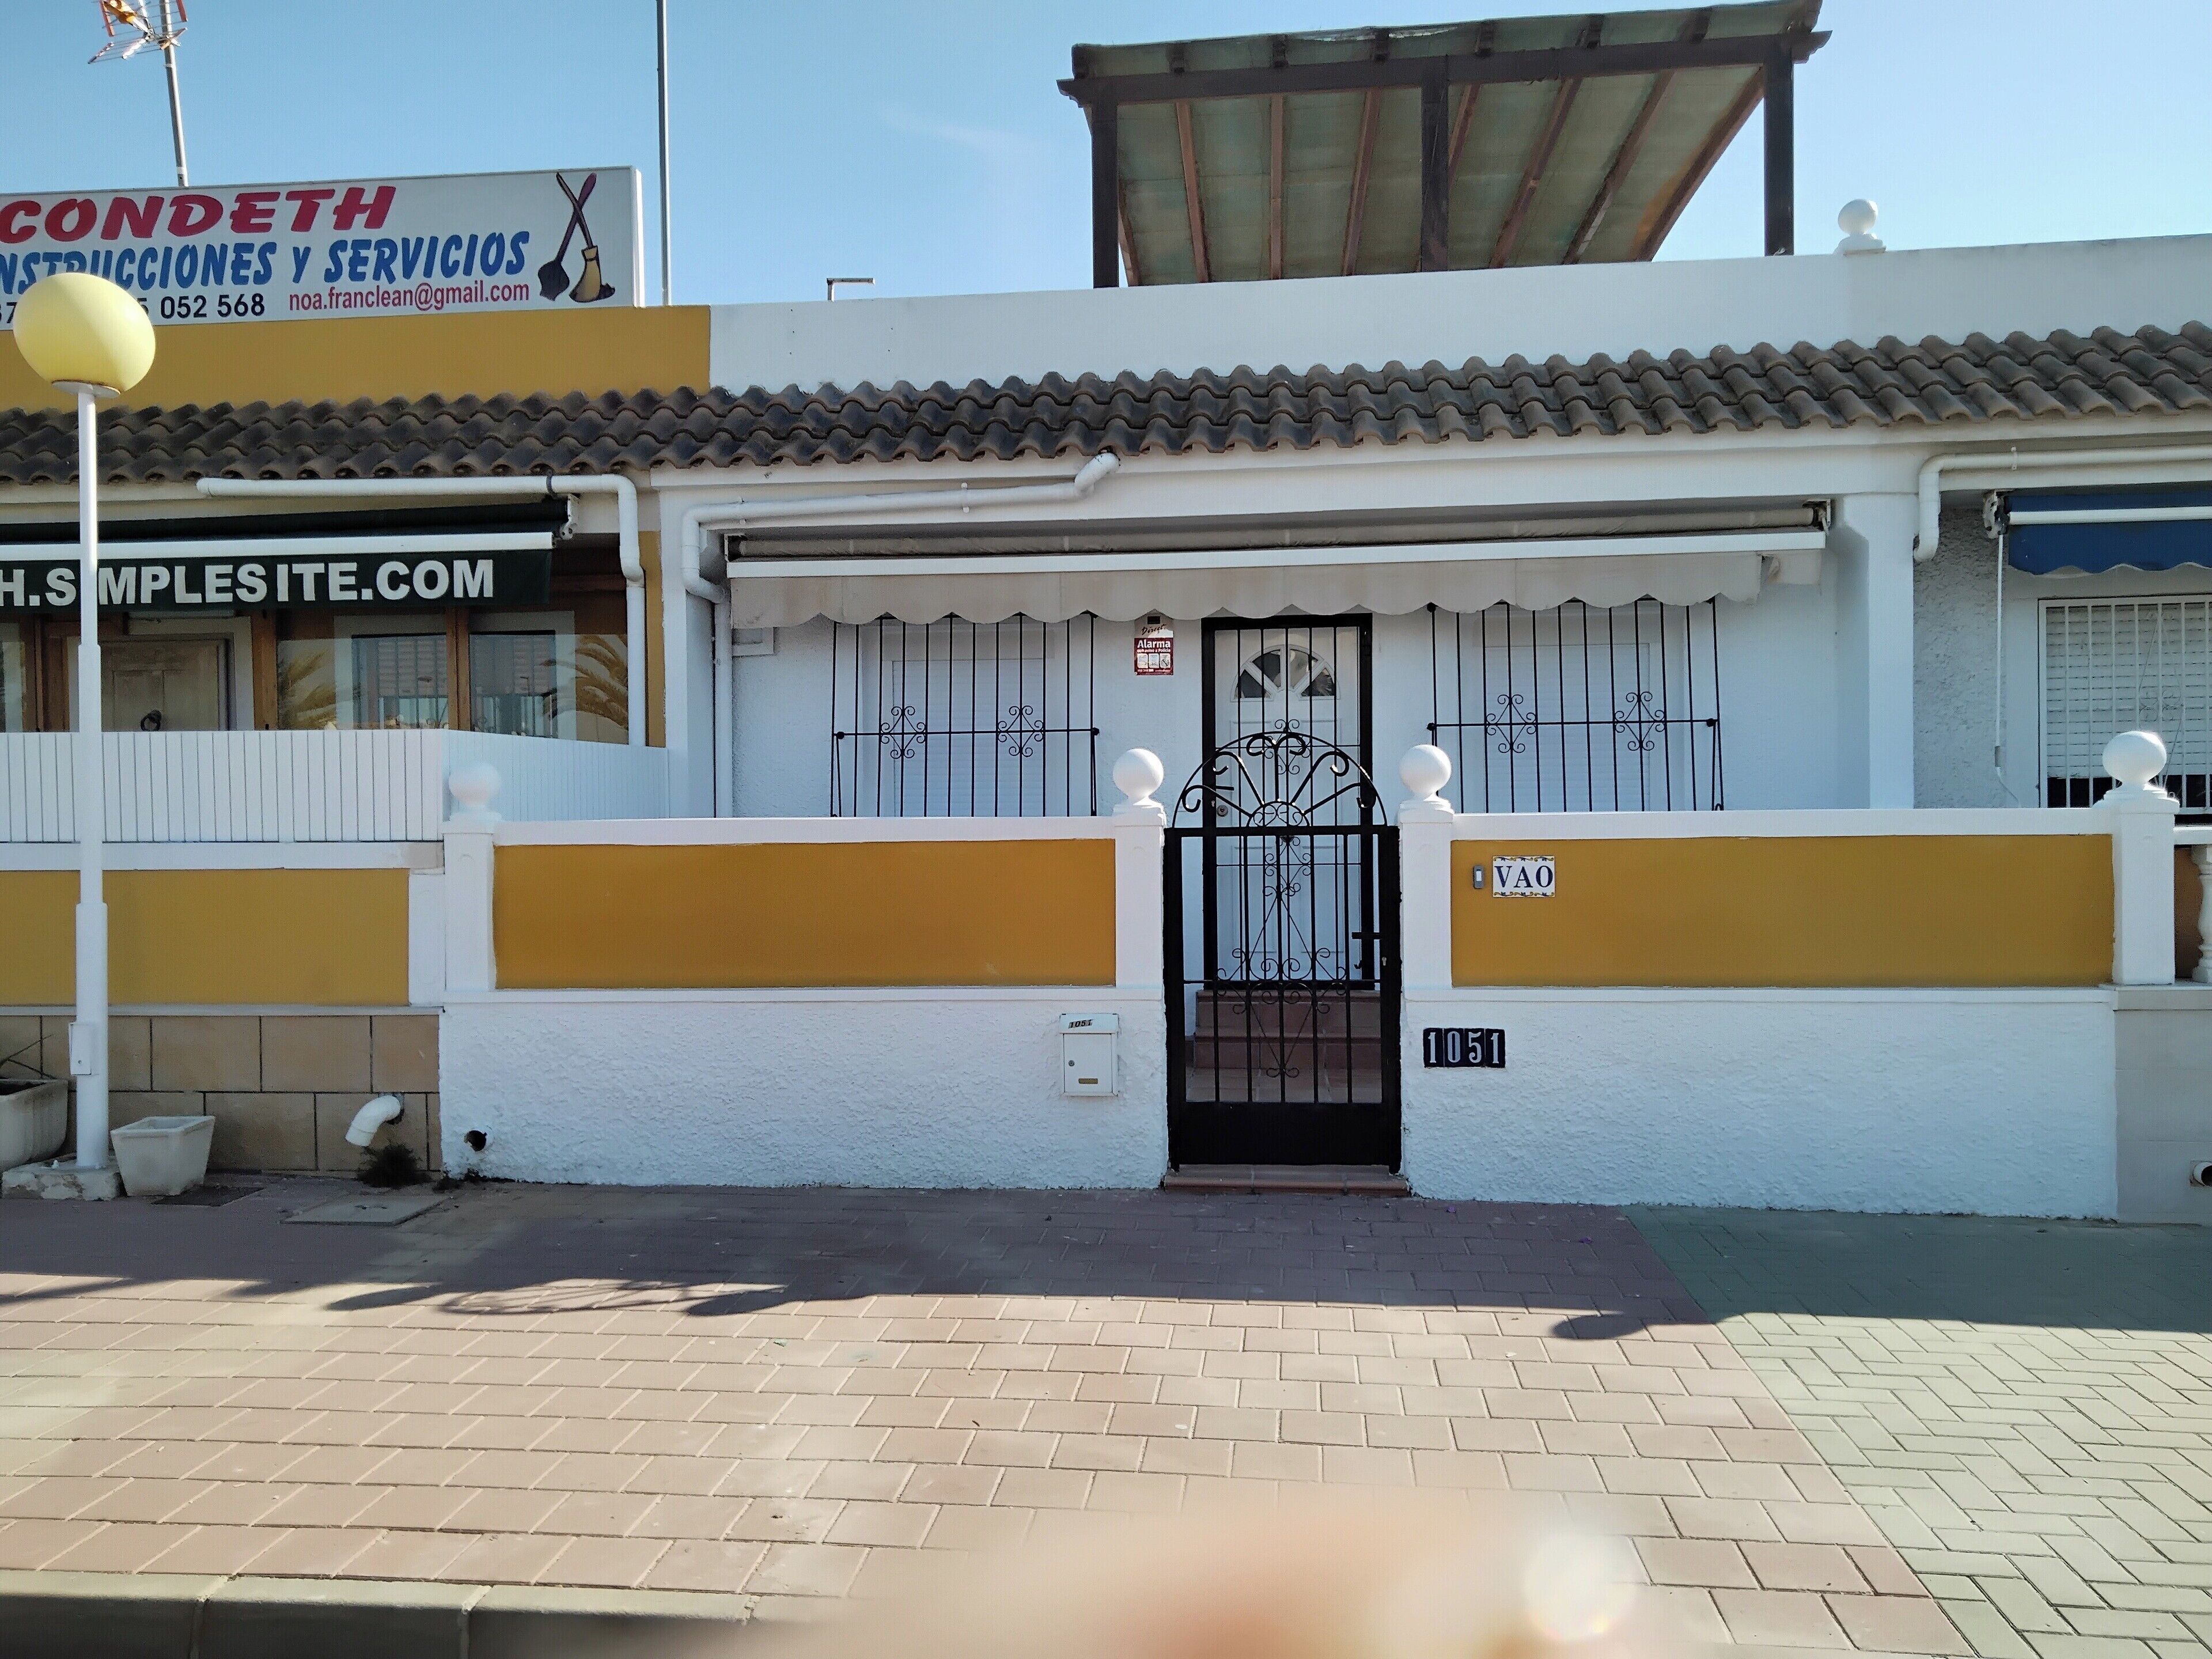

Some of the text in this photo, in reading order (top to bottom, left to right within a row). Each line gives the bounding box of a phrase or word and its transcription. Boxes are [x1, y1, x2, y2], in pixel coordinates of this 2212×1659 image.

[0, 186, 396, 244] CONDETH
[324, 231, 530, 285] SERVICIOS
[161, 294, 207, 319] 052
[217, 293, 265, 316] 568
[289, 280, 529, 311] noa.franclean@gmail.com
[0, 559, 494, 607] H.SMPLESITE.COM
[1137, 639, 1171, 648] Alarma
[1494, 865, 1553, 888] VAO
[1069, 1019, 1093, 1028] 1051
[1427, 1031, 1499, 1064] 1051
